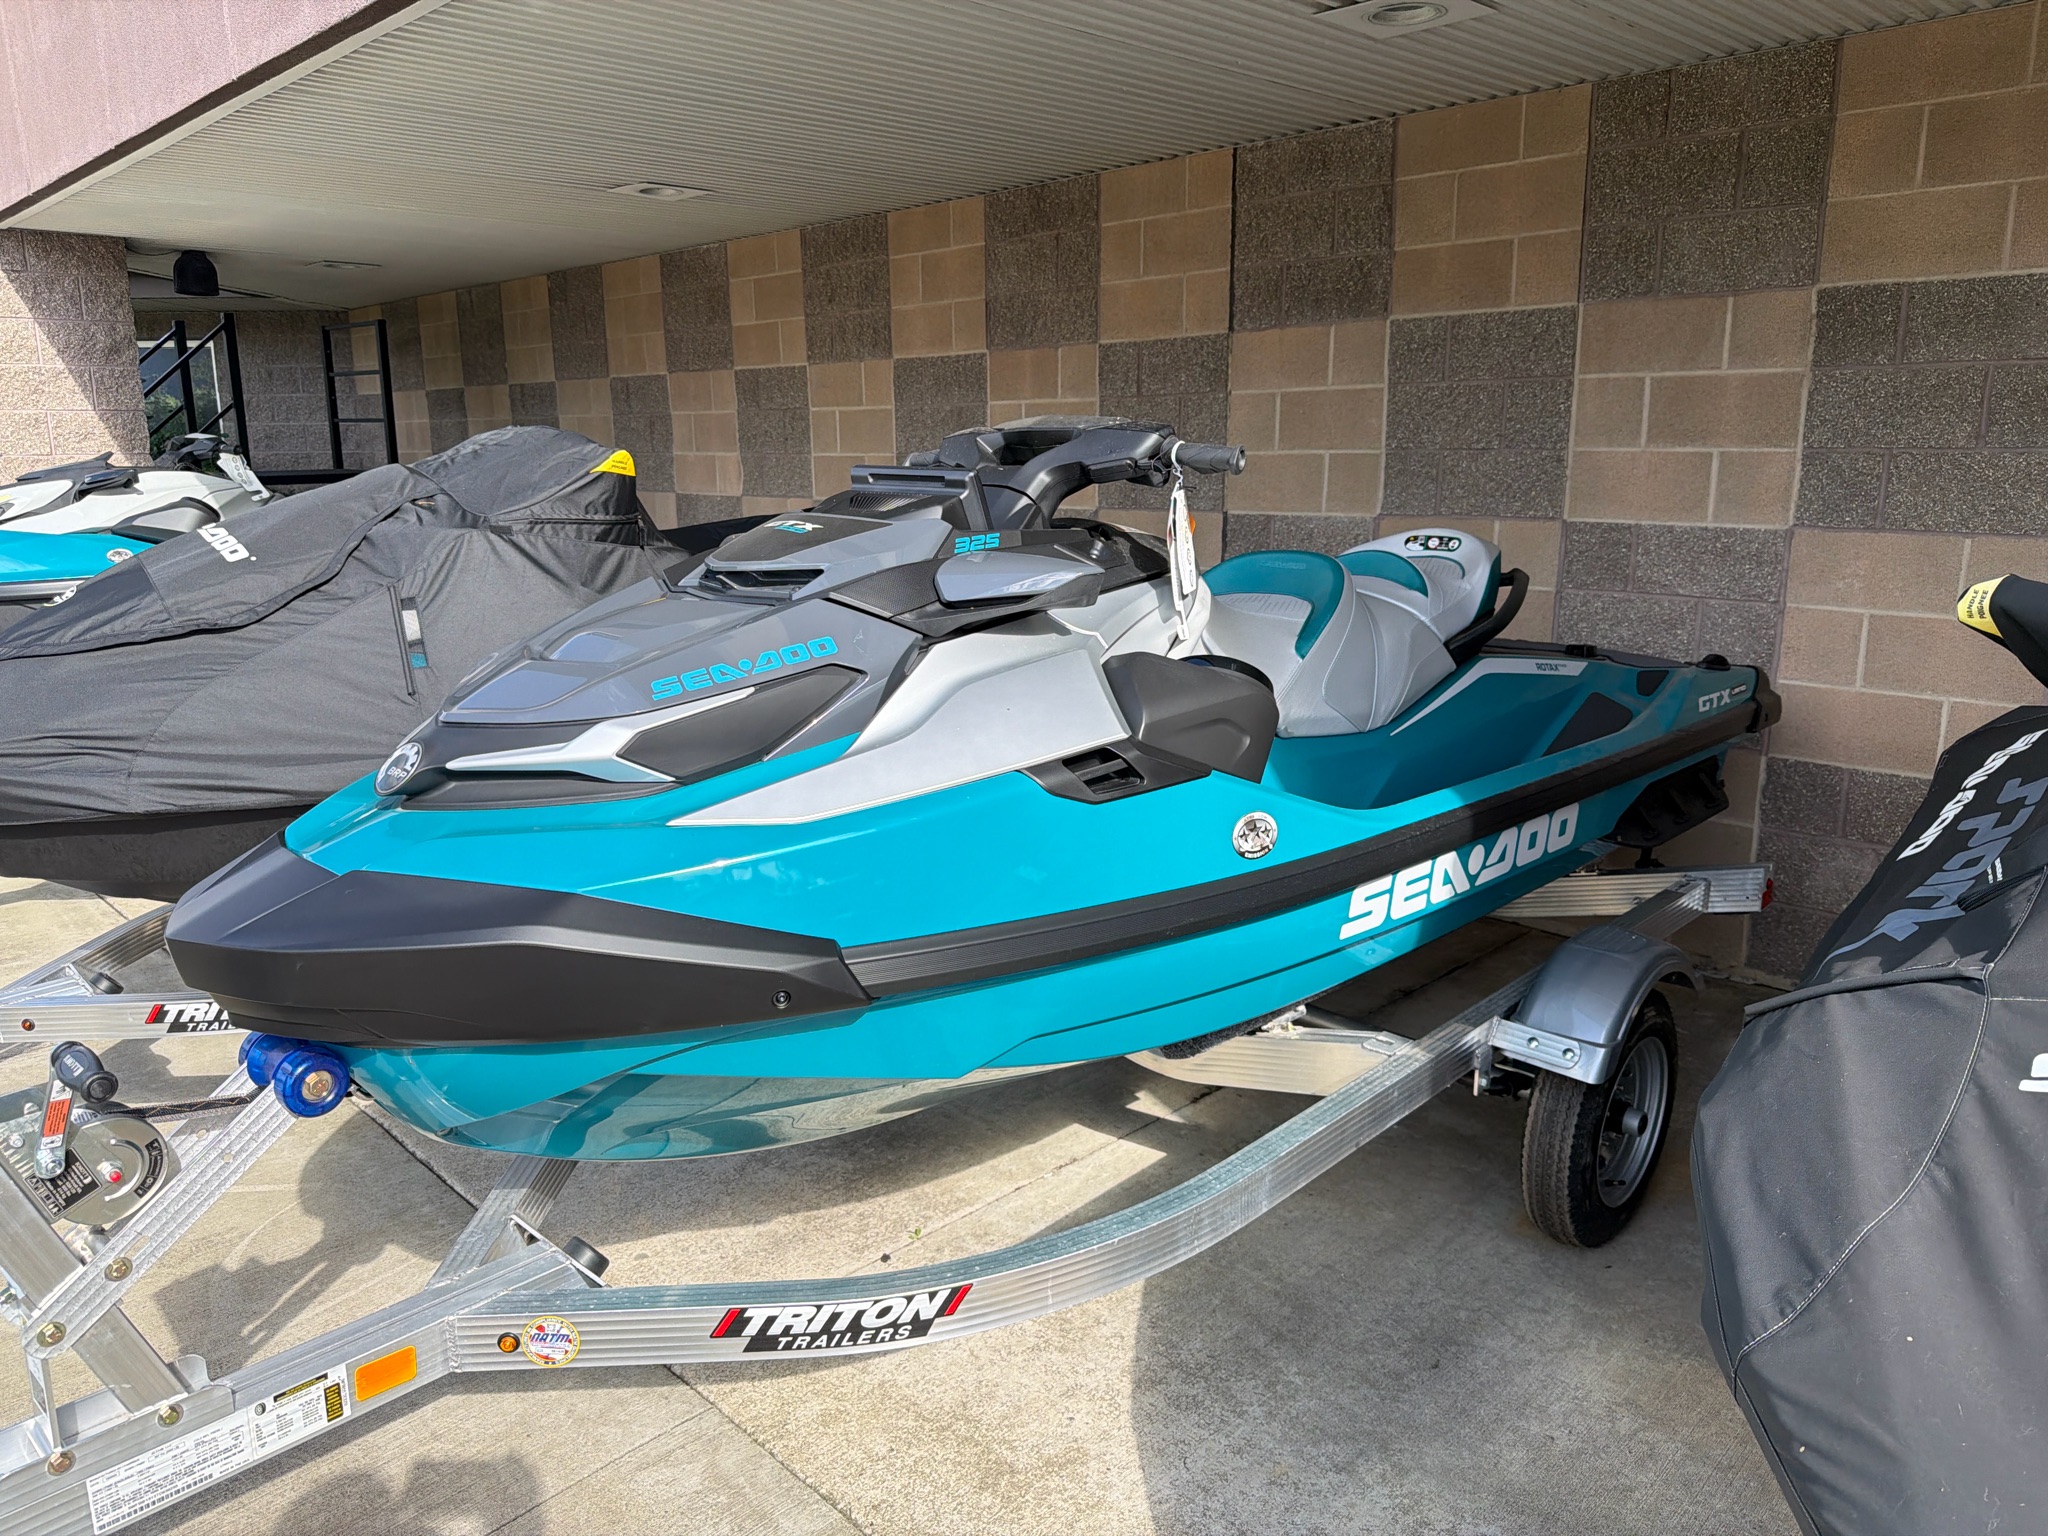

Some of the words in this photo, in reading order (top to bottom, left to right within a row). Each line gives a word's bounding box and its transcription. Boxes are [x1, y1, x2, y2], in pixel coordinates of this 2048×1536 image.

[954, 533, 1000, 554] 325
[1966, 588, 1979, 619] HANDLE
[1698, 688, 1731, 713] GTX
[387, 766, 408, 779] BRP
[741, 1288, 952, 1337] TRITON
[777, 1325, 913, 1350] TRAILERS
